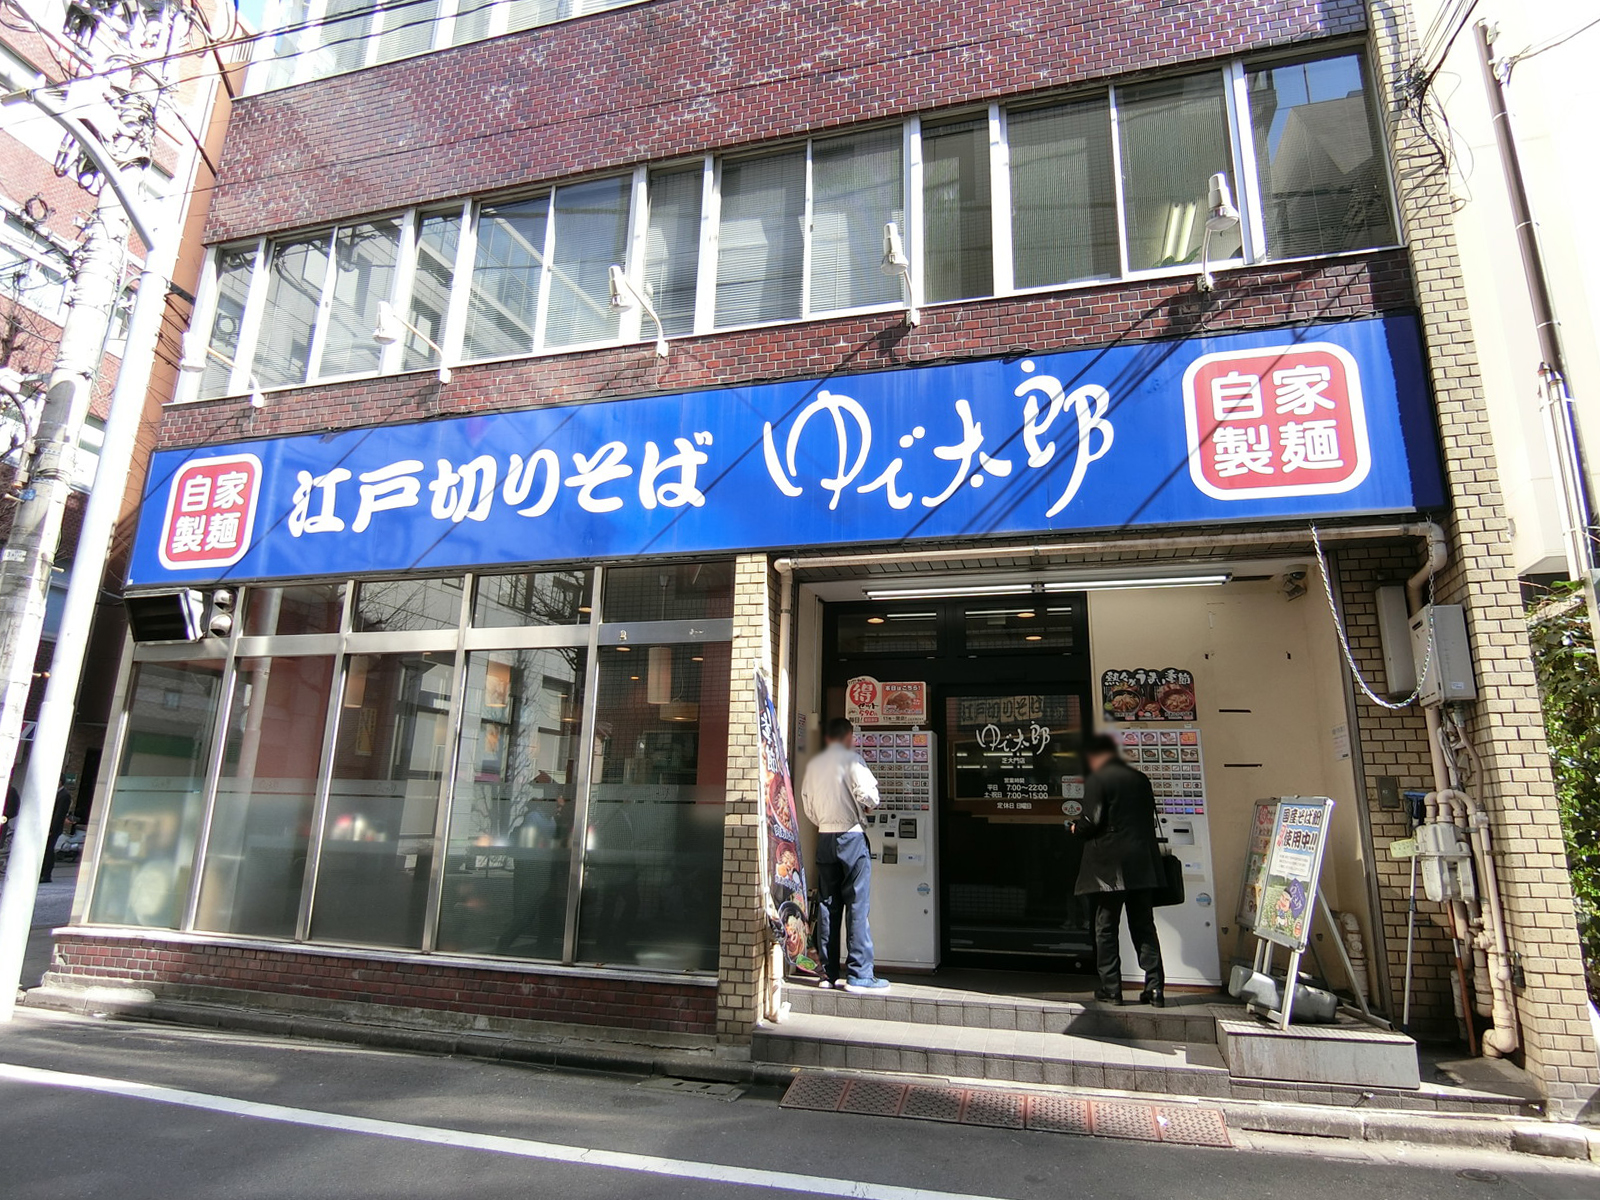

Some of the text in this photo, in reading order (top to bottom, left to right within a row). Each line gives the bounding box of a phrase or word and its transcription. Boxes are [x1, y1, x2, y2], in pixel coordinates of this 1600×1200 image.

[1211, 365, 1335, 421] 自家
[287, 359, 1115, 538] 江戸切りそば ゆで太郎
[1212, 420, 1344, 477] 製麺
[181, 470, 249, 513] 自家
[172, 511, 242, 554] 製麺
[976, 721, 1050, 755] ゆで太郎
